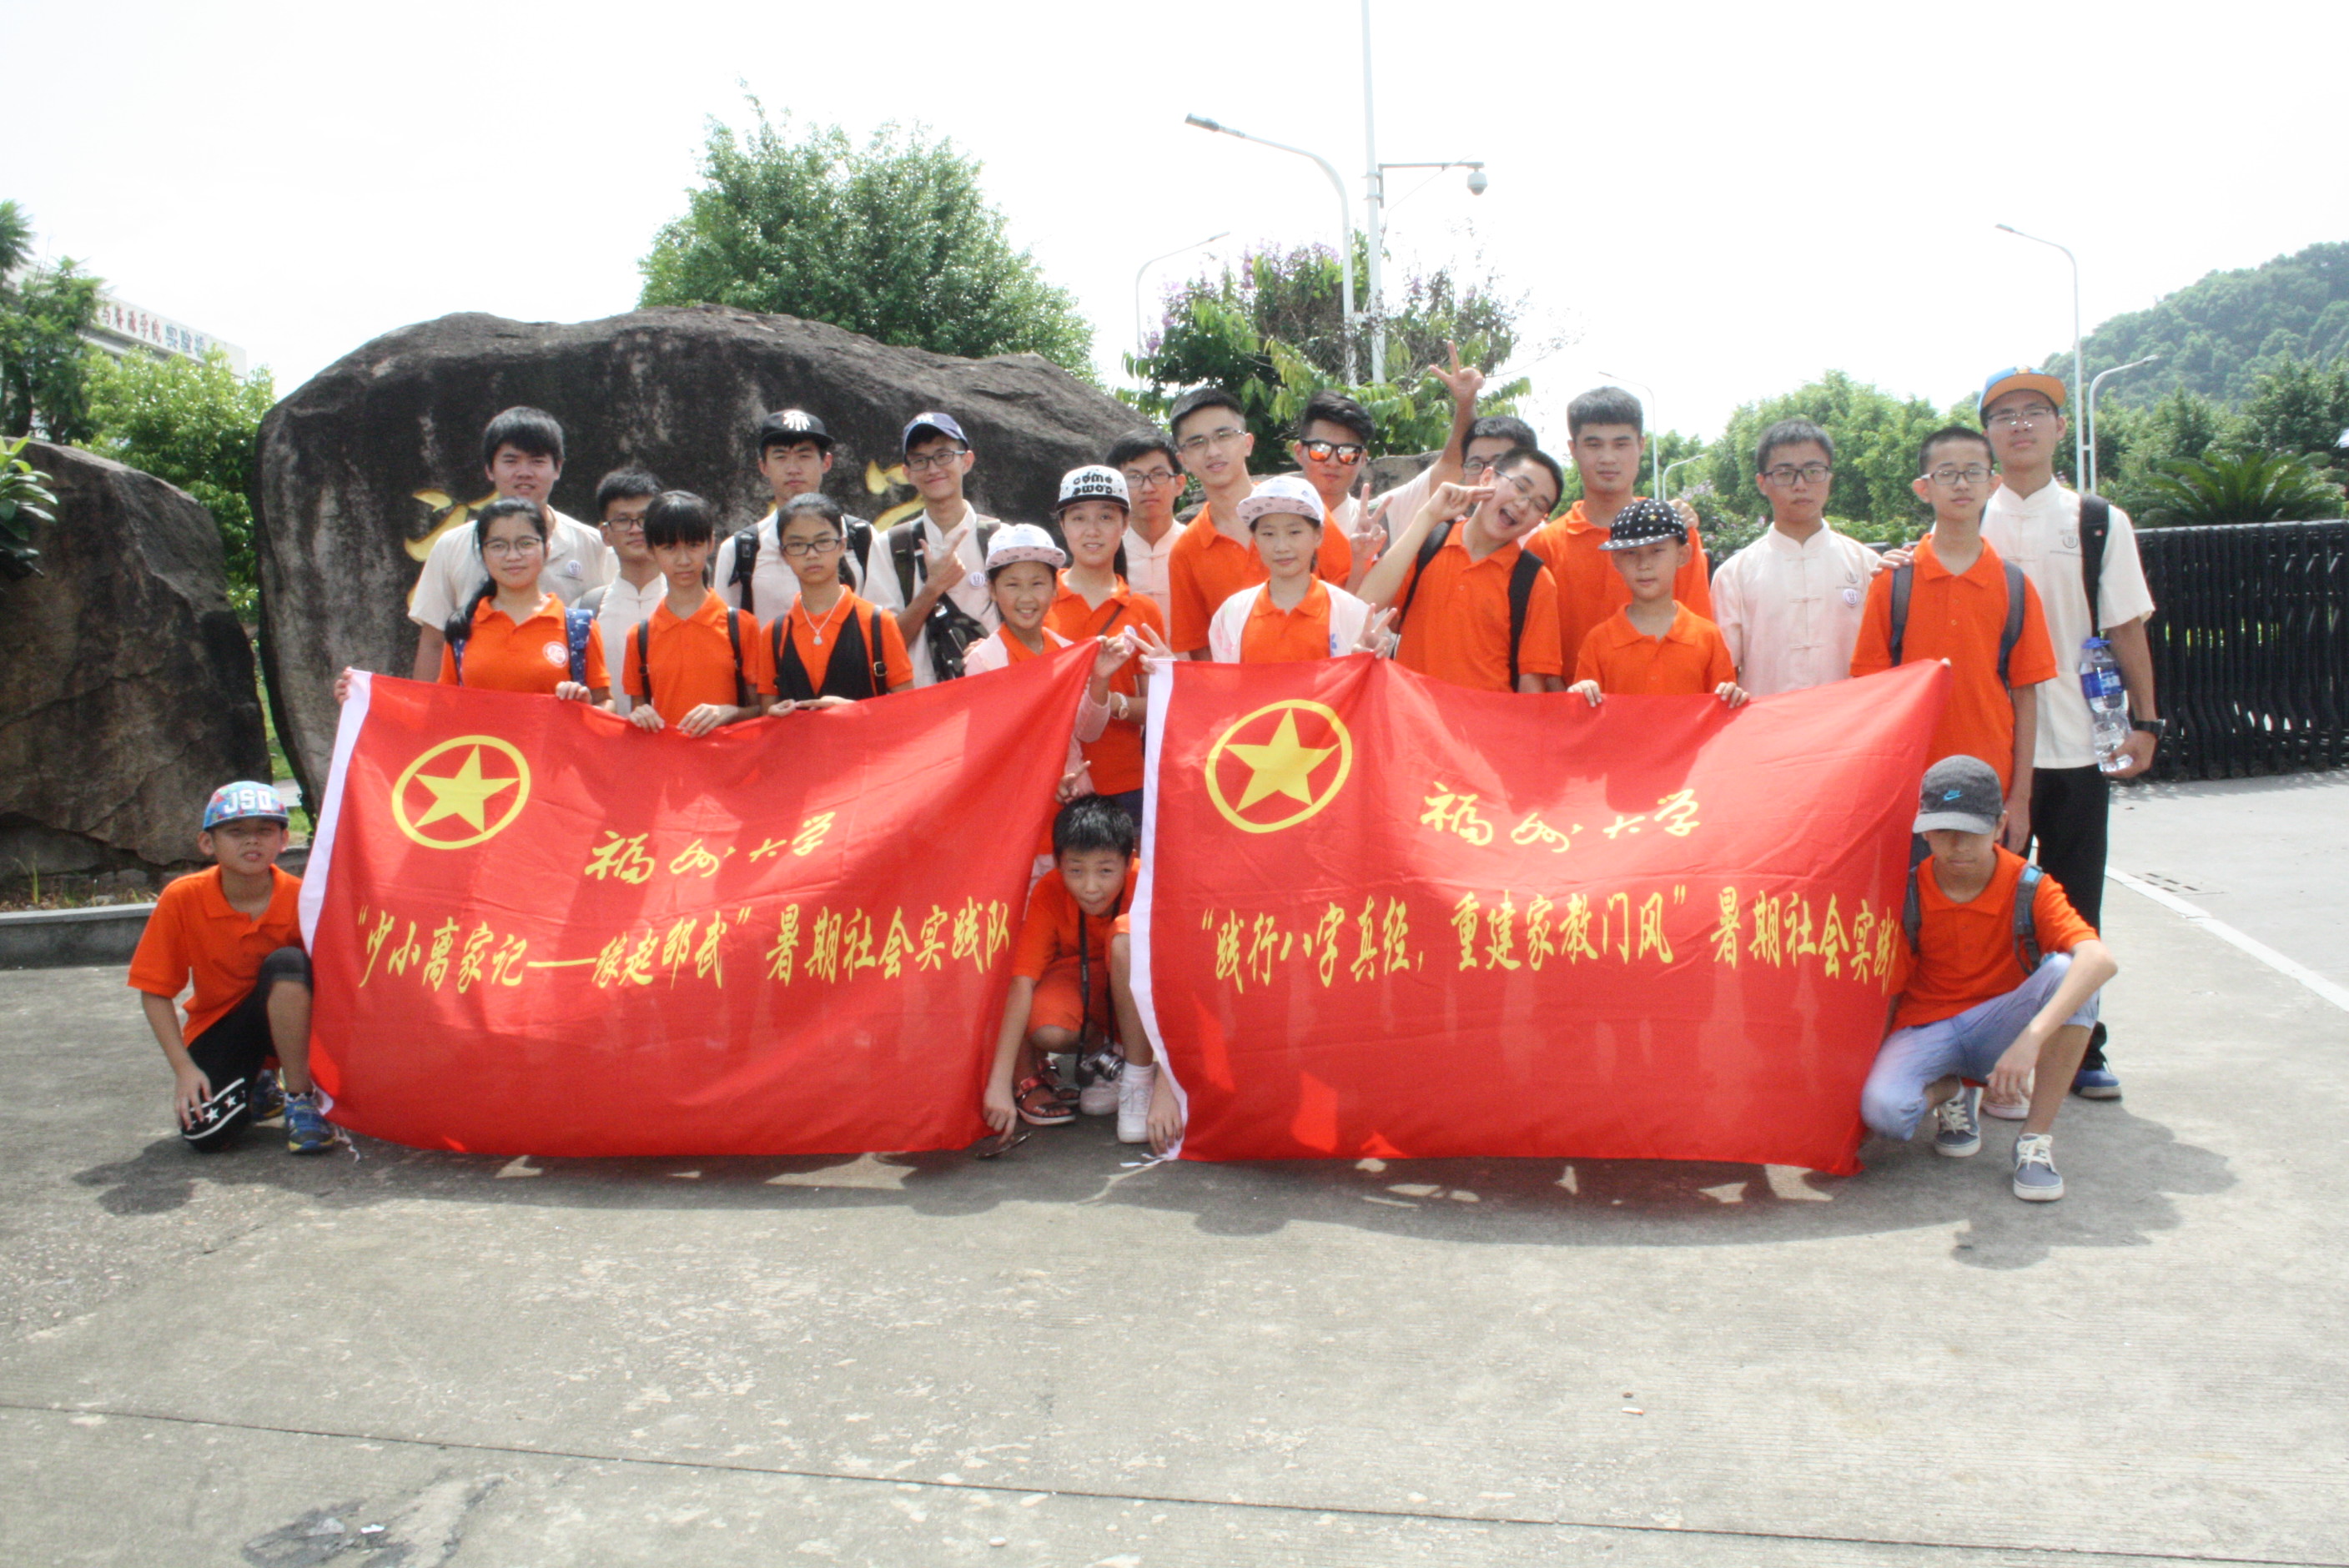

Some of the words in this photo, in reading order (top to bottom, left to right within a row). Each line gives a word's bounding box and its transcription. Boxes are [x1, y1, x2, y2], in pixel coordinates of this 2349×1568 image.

[583, 812, 837, 885] 福州大学
[1420, 781, 1702, 852] 福州大学
